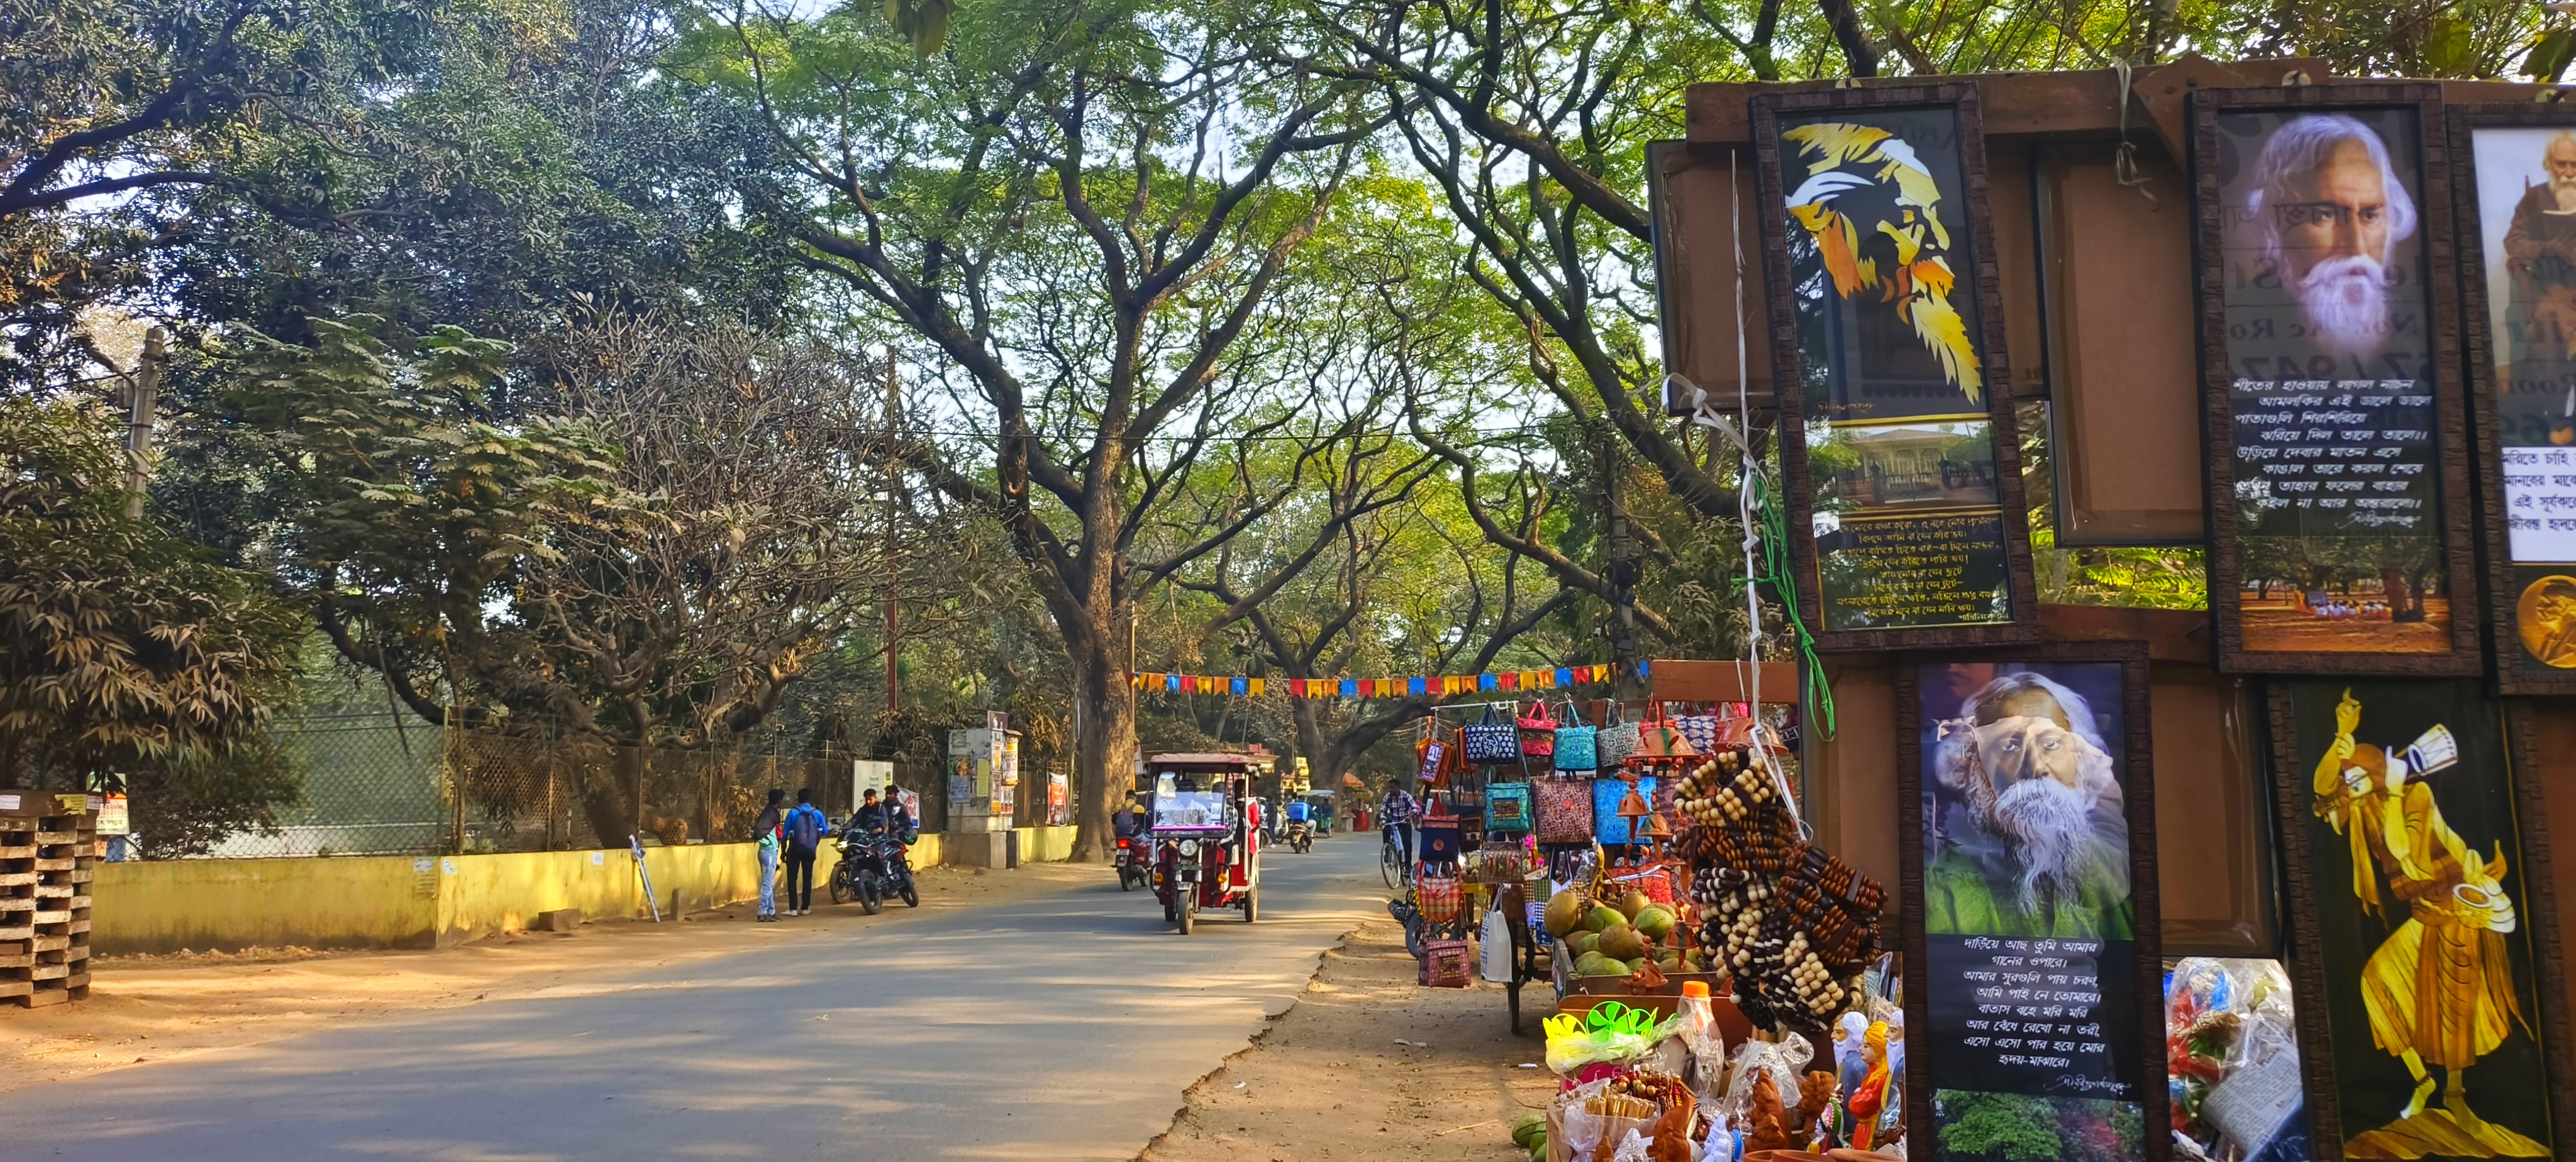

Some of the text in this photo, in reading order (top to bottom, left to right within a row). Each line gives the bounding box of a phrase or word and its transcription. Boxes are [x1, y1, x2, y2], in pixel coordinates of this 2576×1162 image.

[2233, 378, 2274, 392] শীতের
[2282, 380, 2330, 391] হাওয়ায়
[2337, 380, 2375, 390] লাগল
[2328, 394, 2353, 407] এই
[2235, 411, 2294, 424] পাতাগুলি
[2260, 428, 2302, 441] ঝরিয়ে
[2306, 428, 2333, 441] দিল
[2340, 430, 2375, 441] তালে
[2236, 445, 2402, 460] উড়িয়ে দেবার মাতন এসে
[2263, 464, 2305, 475] কাঙাল
[2312, 464, 2345, 475] তারে
[2279, 481, 2319, 492] তাহার
[2325, 481, 2365, 492] ফলের
[2296, 498, 2312, 509] না
[2319, 498, 2348, 508] আর
[2513, 494, 2534, 510] এই
[2005, 940, 2029, 951] আছ
[2034, 938, 2057, 954] তুমি
[2062, 942, 2098, 953] আমার
[1991, 956, 2068, 968] গানের ওপারে।
[1963, 971, 2098, 987] আমার সুরগুলি পায় চরণ,
[1977, 985, 2101, 1003] আমি পাই নে তোমারে।
[1978, 1004, 2089, 1019] বাতাস বহে মরি মরি
[1966, 1019, 2100, 1038] আর বেঁধে রেখো না তরী,
[1963, 1036, 2106, 1053] এসো এসো পার হয়ে মোর
